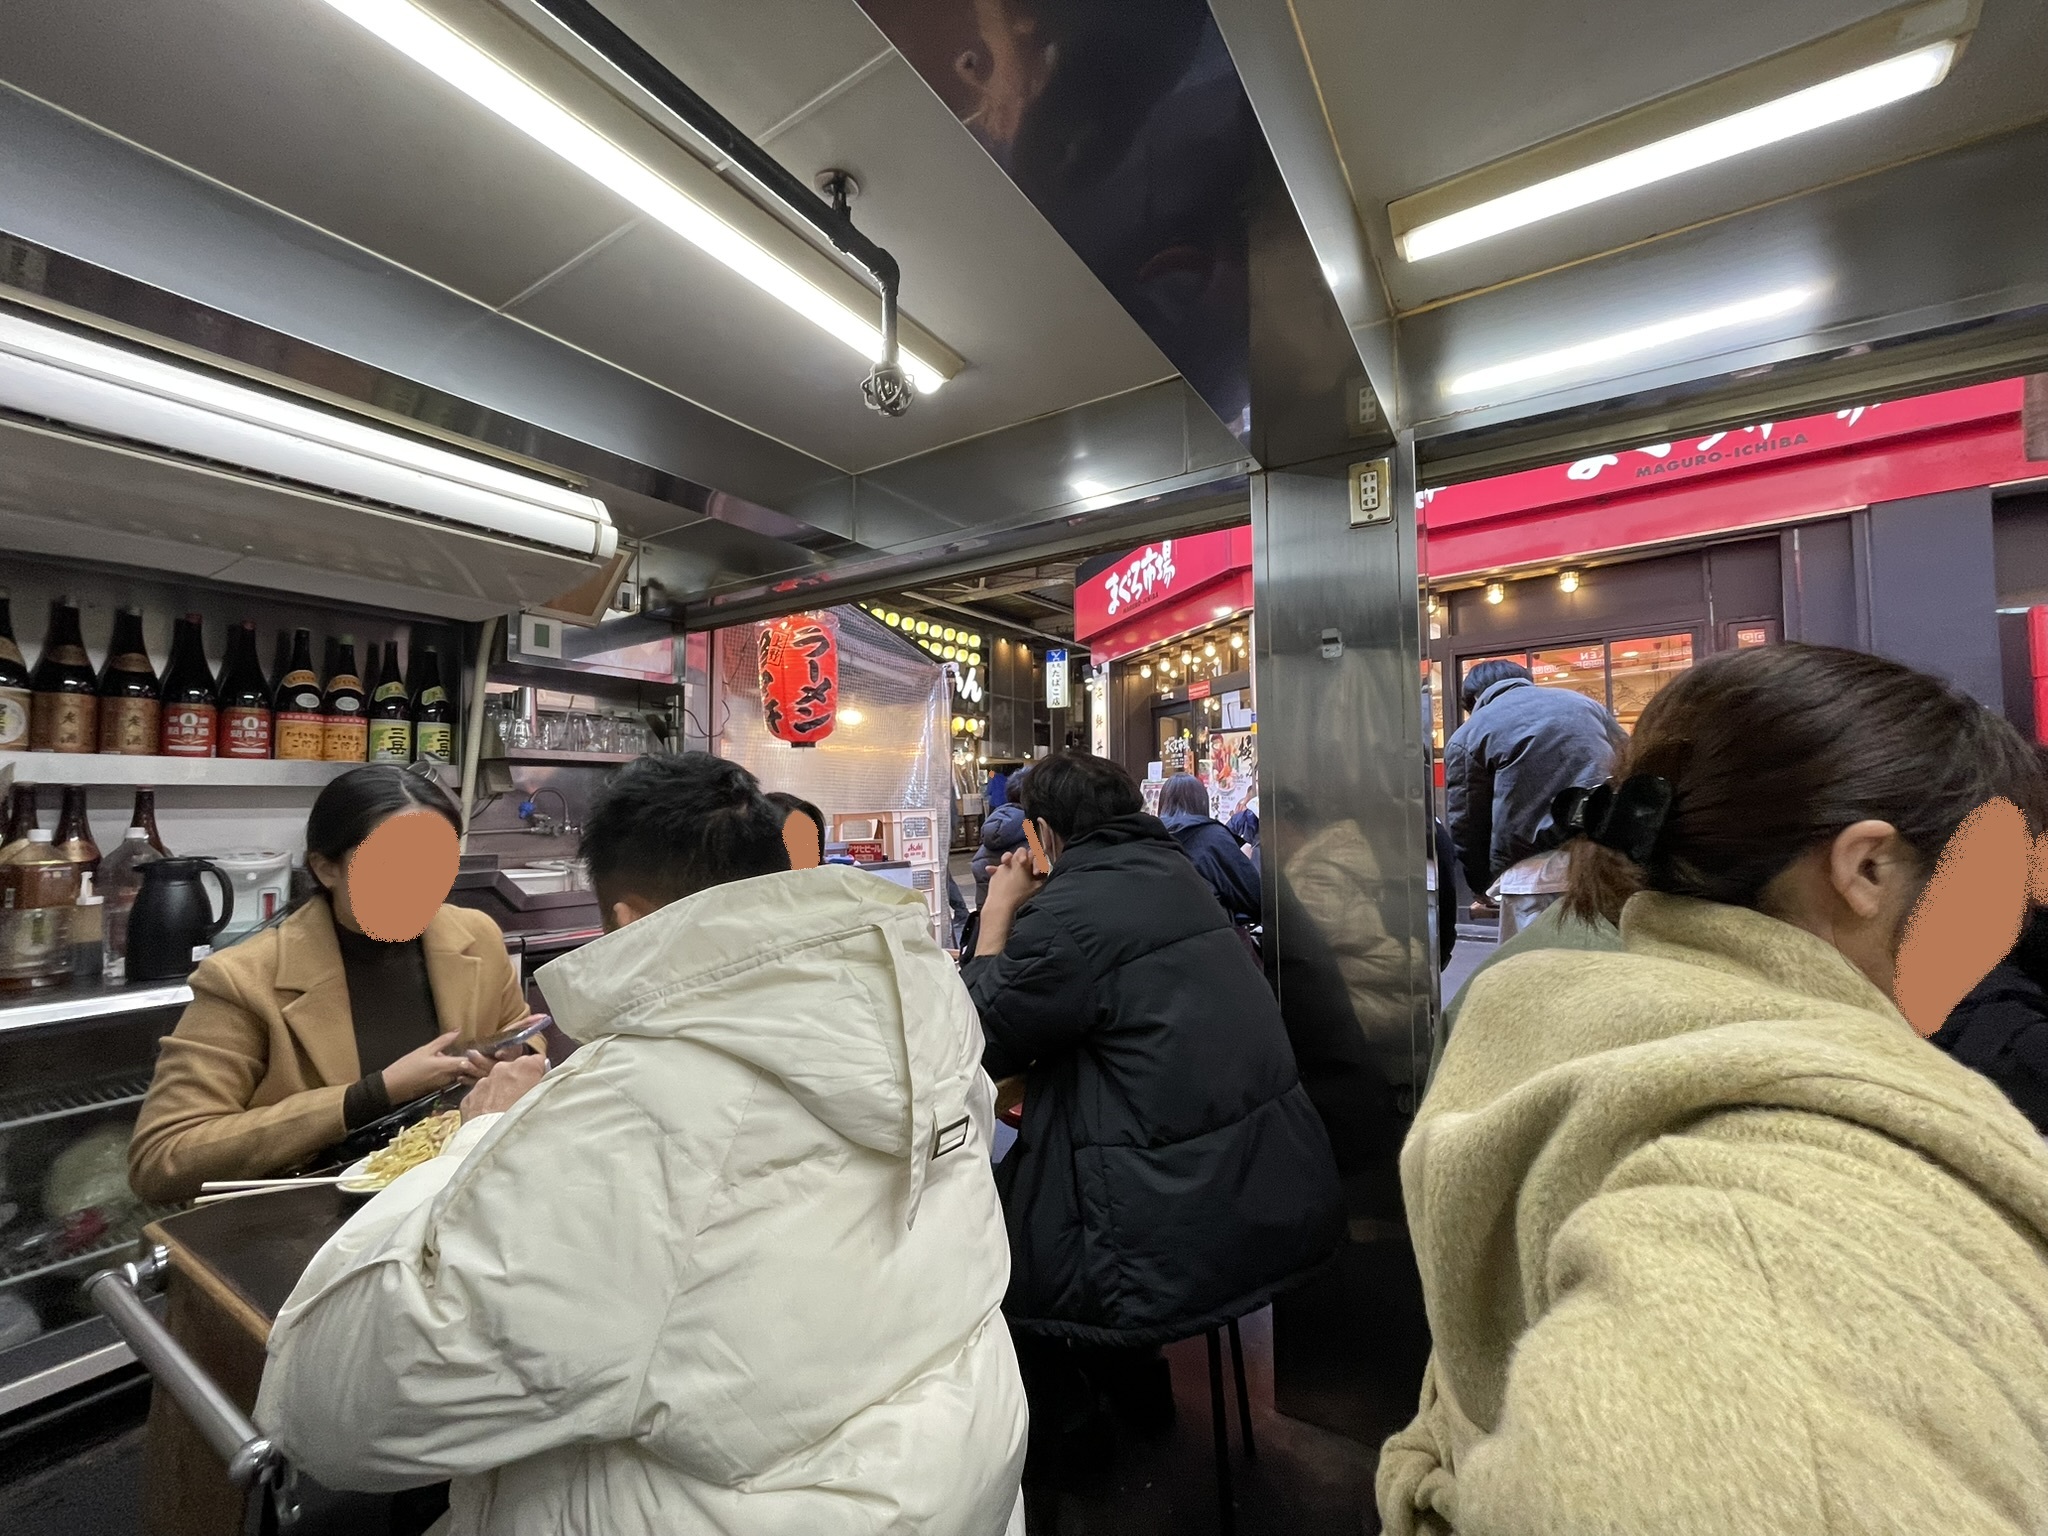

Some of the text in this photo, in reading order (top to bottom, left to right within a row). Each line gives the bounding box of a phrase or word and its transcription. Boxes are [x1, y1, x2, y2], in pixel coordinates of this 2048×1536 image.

[1635, 433, 1809, 478] MAGURO-ICHIBA
[1105, 540, 1176, 615] まぐろ市場
[792, 626, 832, 733] ラーメン
[1051, 670, 1063, 706] たばこ店
[387, 727, 407, 755] 三岳
[848, 844, 881, 854] アサヒビール
[907, 842, 923, 852] Asahi
